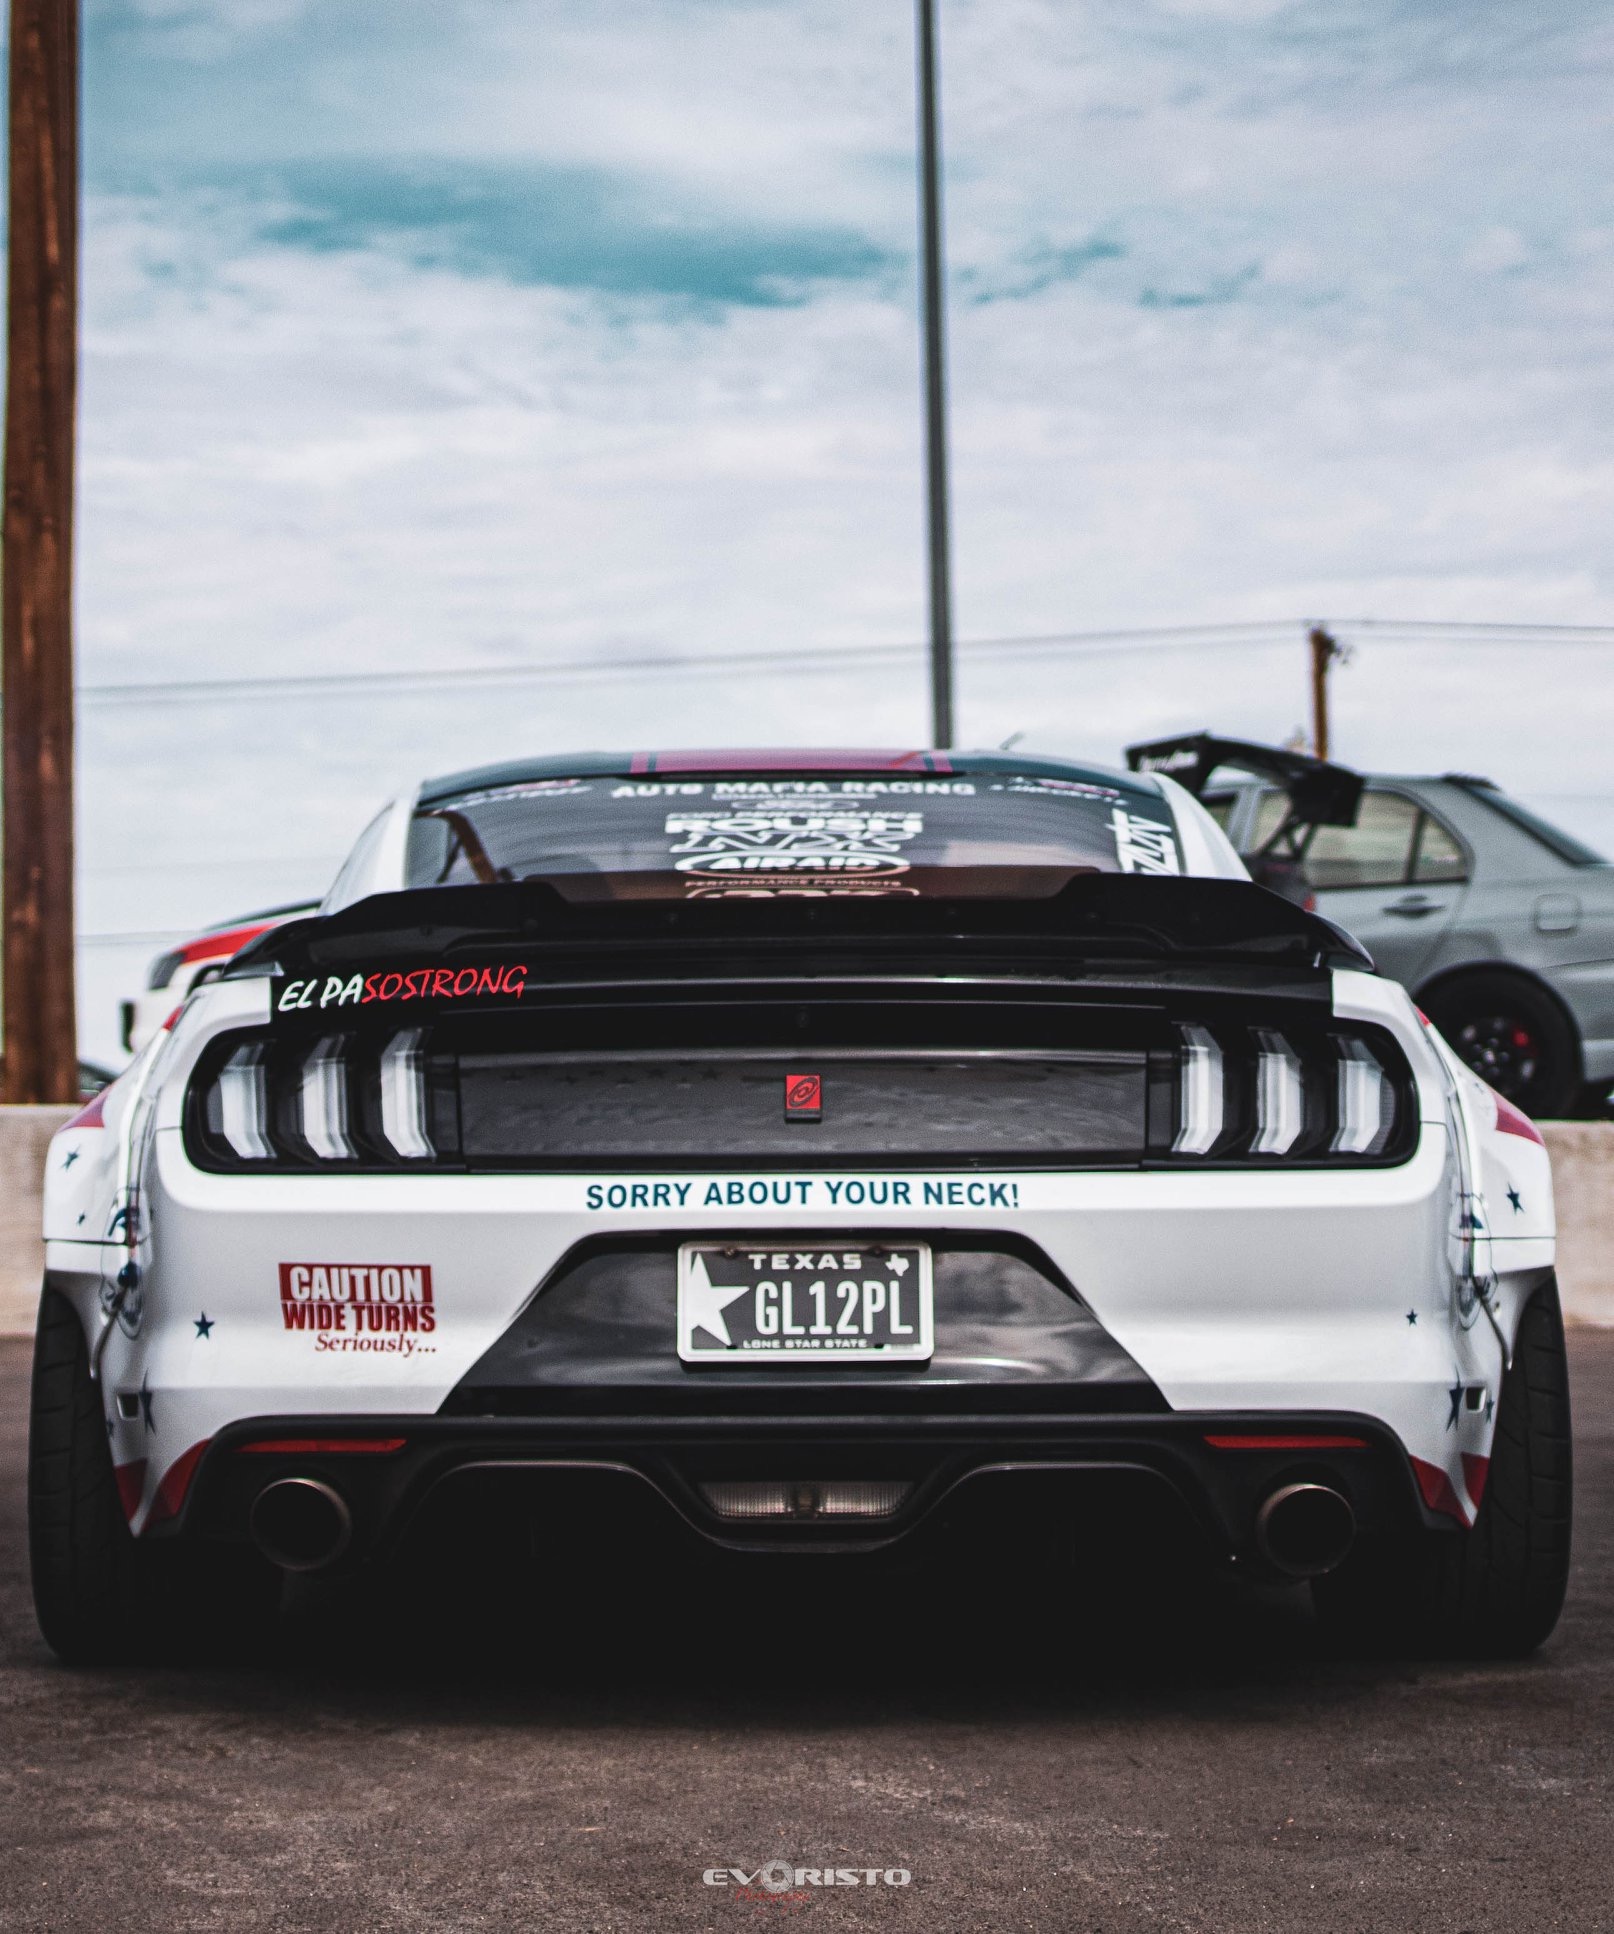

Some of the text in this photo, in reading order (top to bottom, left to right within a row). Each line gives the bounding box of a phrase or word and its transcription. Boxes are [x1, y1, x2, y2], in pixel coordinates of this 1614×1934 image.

[611, 783, 703, 798] AUTO
[714, 782, 829, 794] MAFIA
[841, 782, 976, 796] RACING
[664, 818, 922, 833] ROUSH
[709, 856, 880, 870] AIRAID
[685, 879, 901, 889] PERFORMANCE PRODUCTS
[278, 979, 318, 1012] EL
[586, 1181, 1019, 1210] SORRY ABOUT YOUR NECK!
[748, 1253, 862, 1270] TEXAS
[290, 1266, 424, 1303] CAUTION
[281, 1303, 435, 1332] WIDE TURNS
[755, 1280, 913, 1335] GL12PL
[314, 1332, 436, 1358] Seriously...
[743, 1339, 867, 1349] LONE STAR STATE
